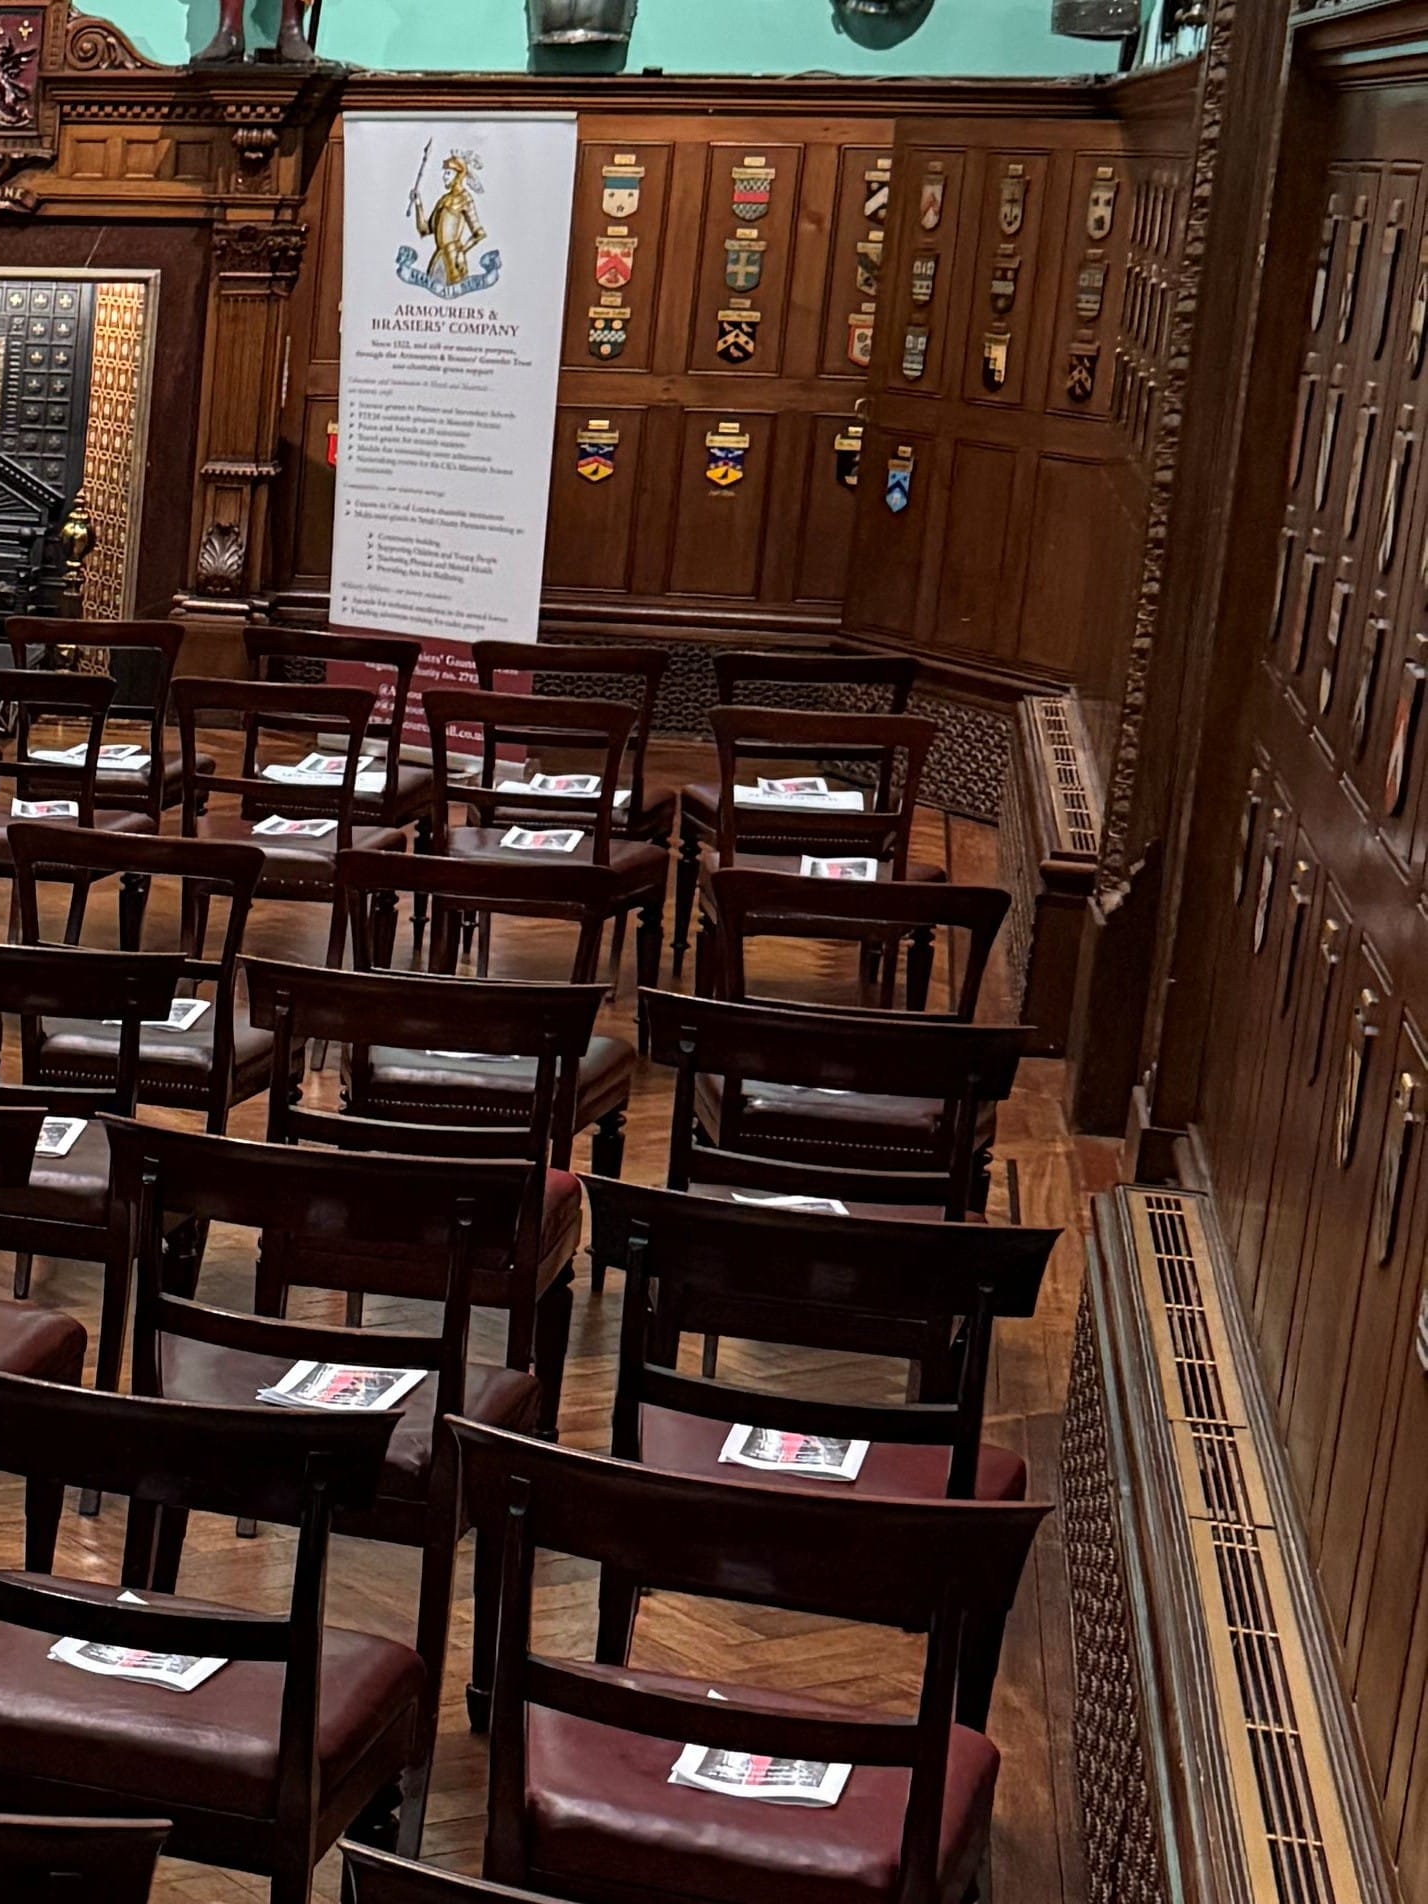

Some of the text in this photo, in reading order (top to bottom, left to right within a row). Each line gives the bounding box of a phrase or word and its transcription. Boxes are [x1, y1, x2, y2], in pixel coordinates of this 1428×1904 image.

[394, 303, 498, 321] ARMOURERS &
[371, 318, 520, 337] BRASIERS' COMPANY
